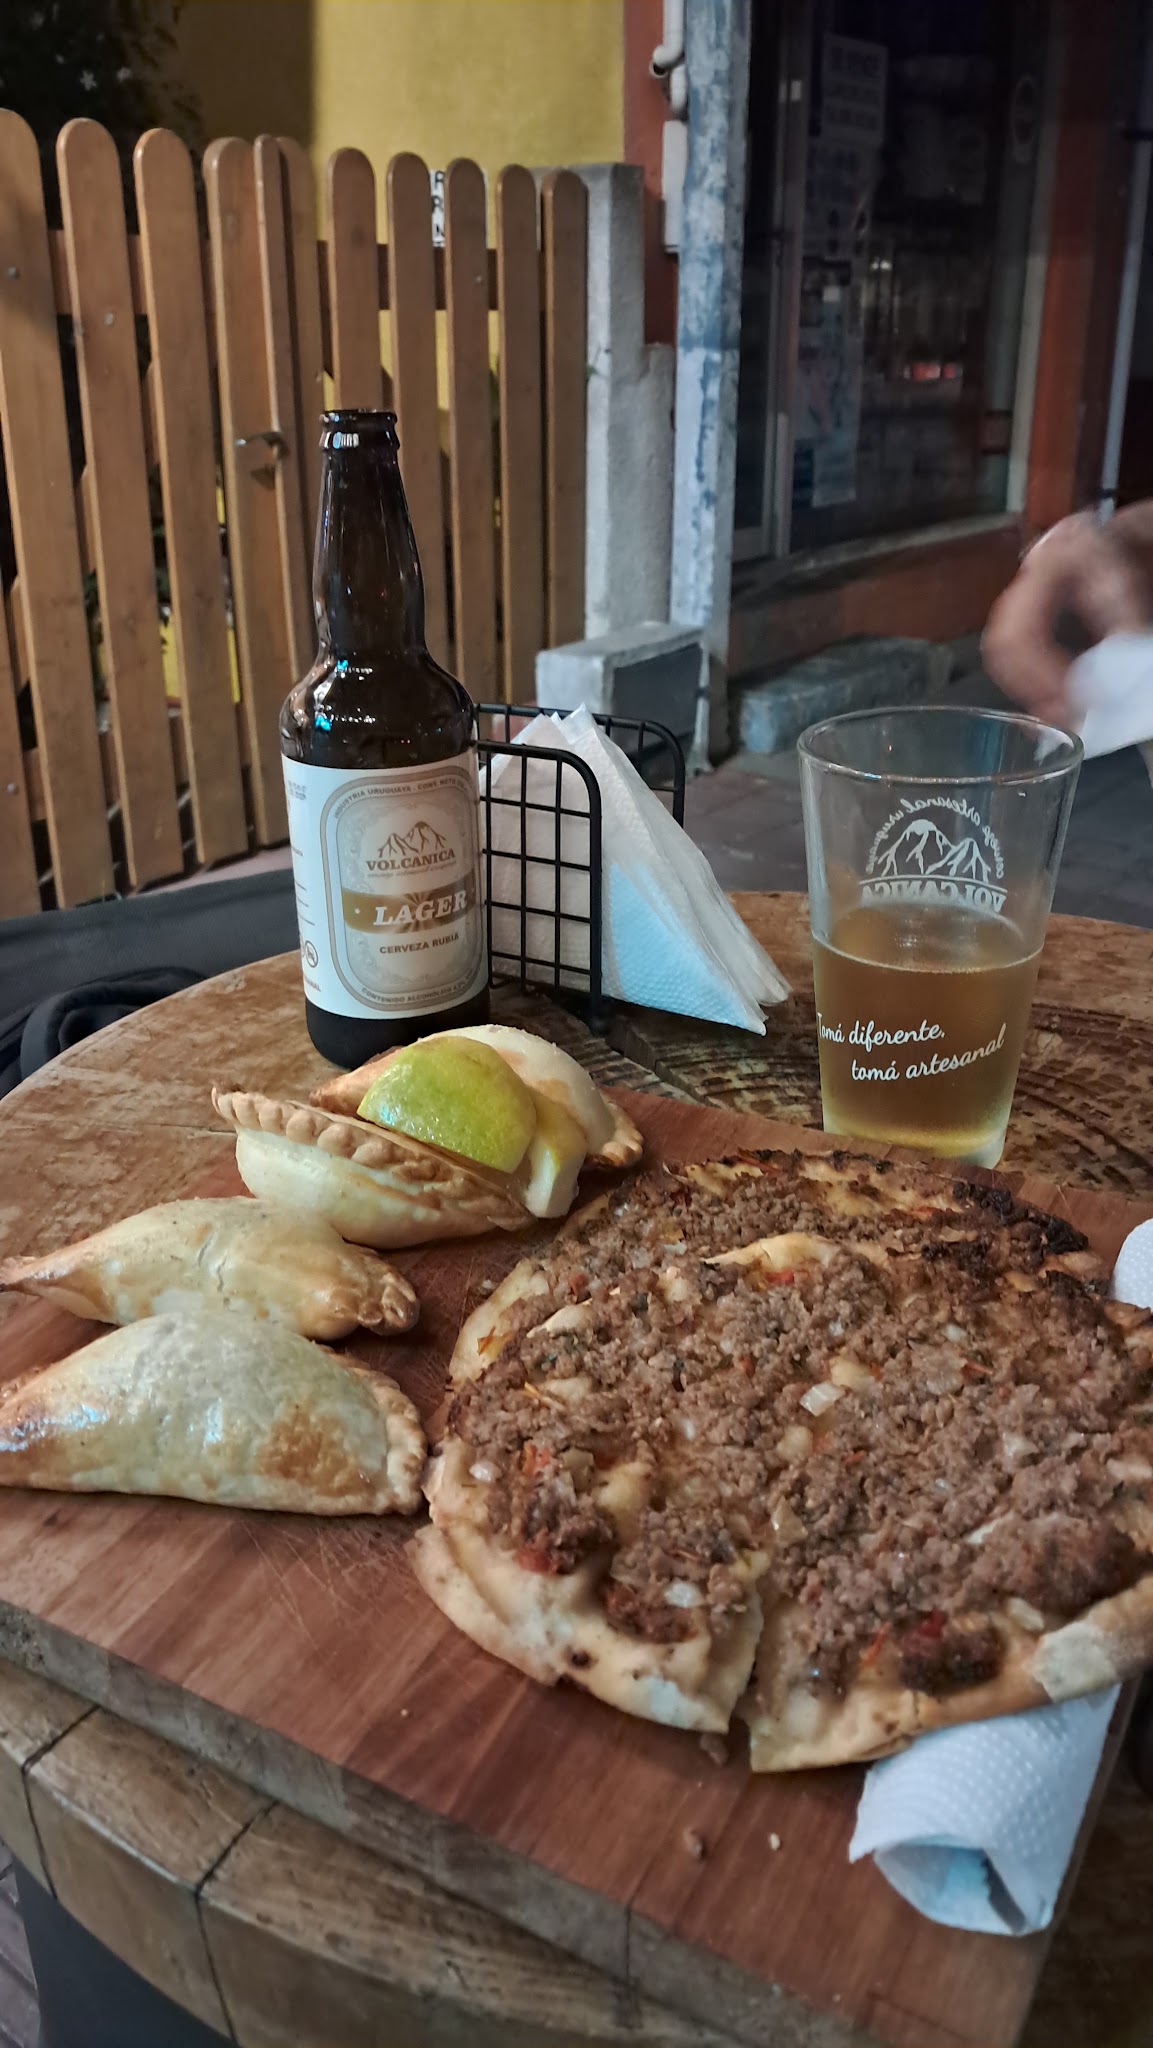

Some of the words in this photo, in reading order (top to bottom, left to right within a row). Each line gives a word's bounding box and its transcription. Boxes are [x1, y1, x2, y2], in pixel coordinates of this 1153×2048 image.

[366, 848, 456, 871] VOLCANICA
[373, 889, 468, 926] LAGER
[379, 942, 430, 954] CERVEZA
[432, 932, 460, 946] RUBIA
[361, 987, 406, 1003] CONTENIDO
[817, 1012, 845, 1043] Tomá
[849, 1019, 946, 1052] diferente.
[851, 1059, 900, 1081] tomá
[905, 1022, 1007, 1079] artesanal
